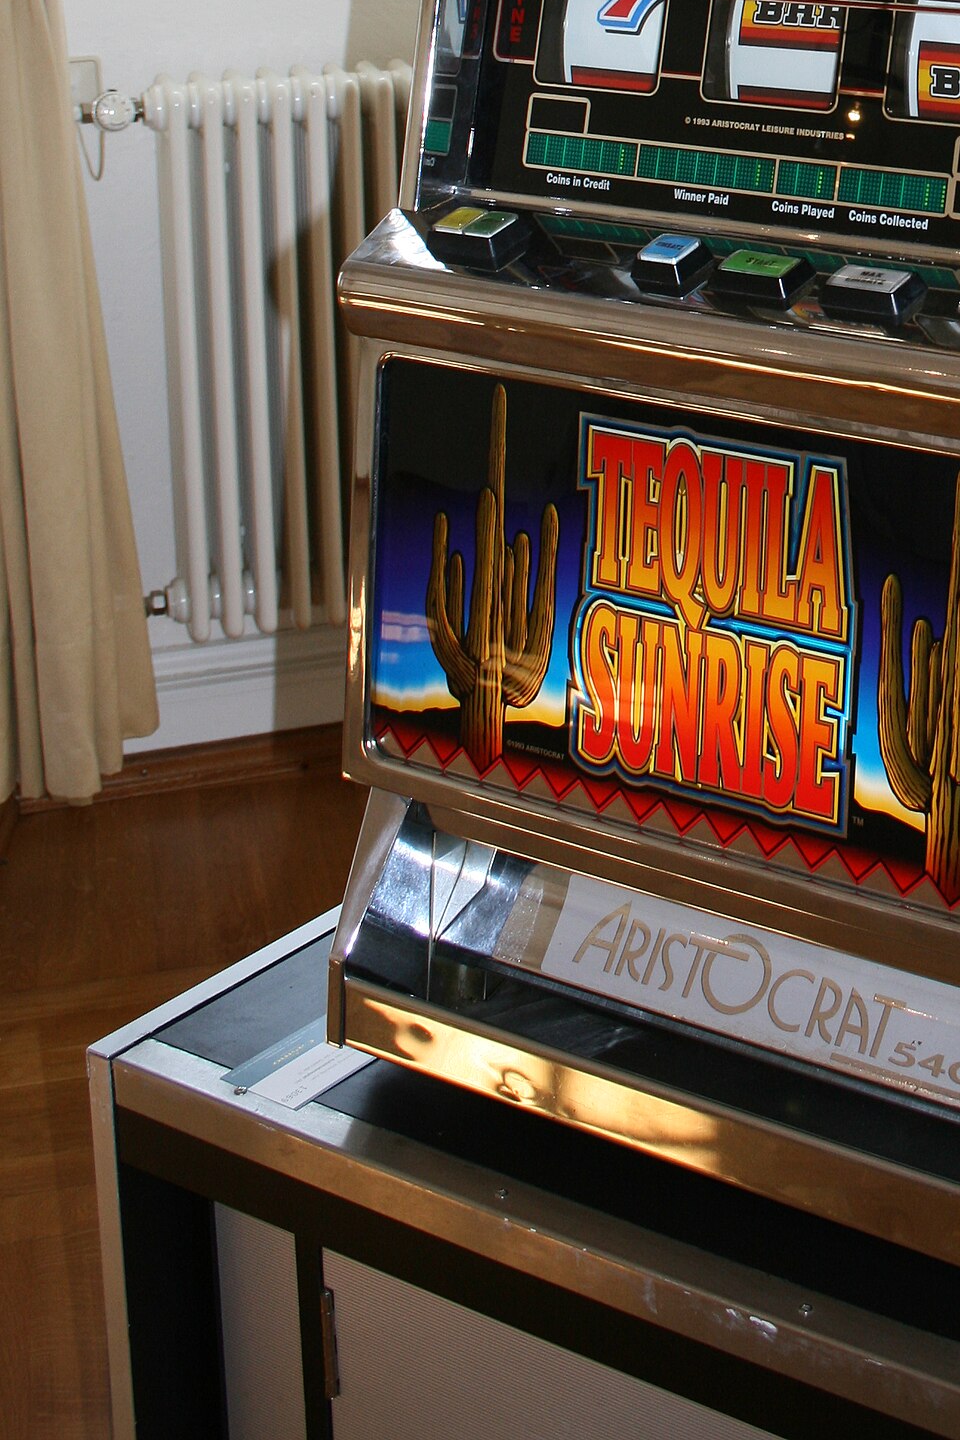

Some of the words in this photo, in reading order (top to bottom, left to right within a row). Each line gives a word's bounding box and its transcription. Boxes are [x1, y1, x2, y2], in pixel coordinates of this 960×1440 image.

[711, 119, 760, 131] ARISTOCRAT
[762, 124, 795, 135] LEISURE
[796, 128, 844, 140] INDUSTRIES
[546, 172, 571, 187] Coins
[572, 176, 582, 187] in
[583, 177, 610, 191] Credit
[674, 188, 706, 203] Winner
[708, 192, 729, 206] Paid
[771, 200, 800, 215] Coins
[801, 203, 835, 220] Played
[848, 209, 877, 225] Coins
[879, 213, 929, 231] Collected
[588, 425, 848, 642] TEQUILA
[578, 599, 847, 825] SUNRISE
[852, 815, 865, 825] TM
[571, 901, 907, 1060] ARISTOCRAT
